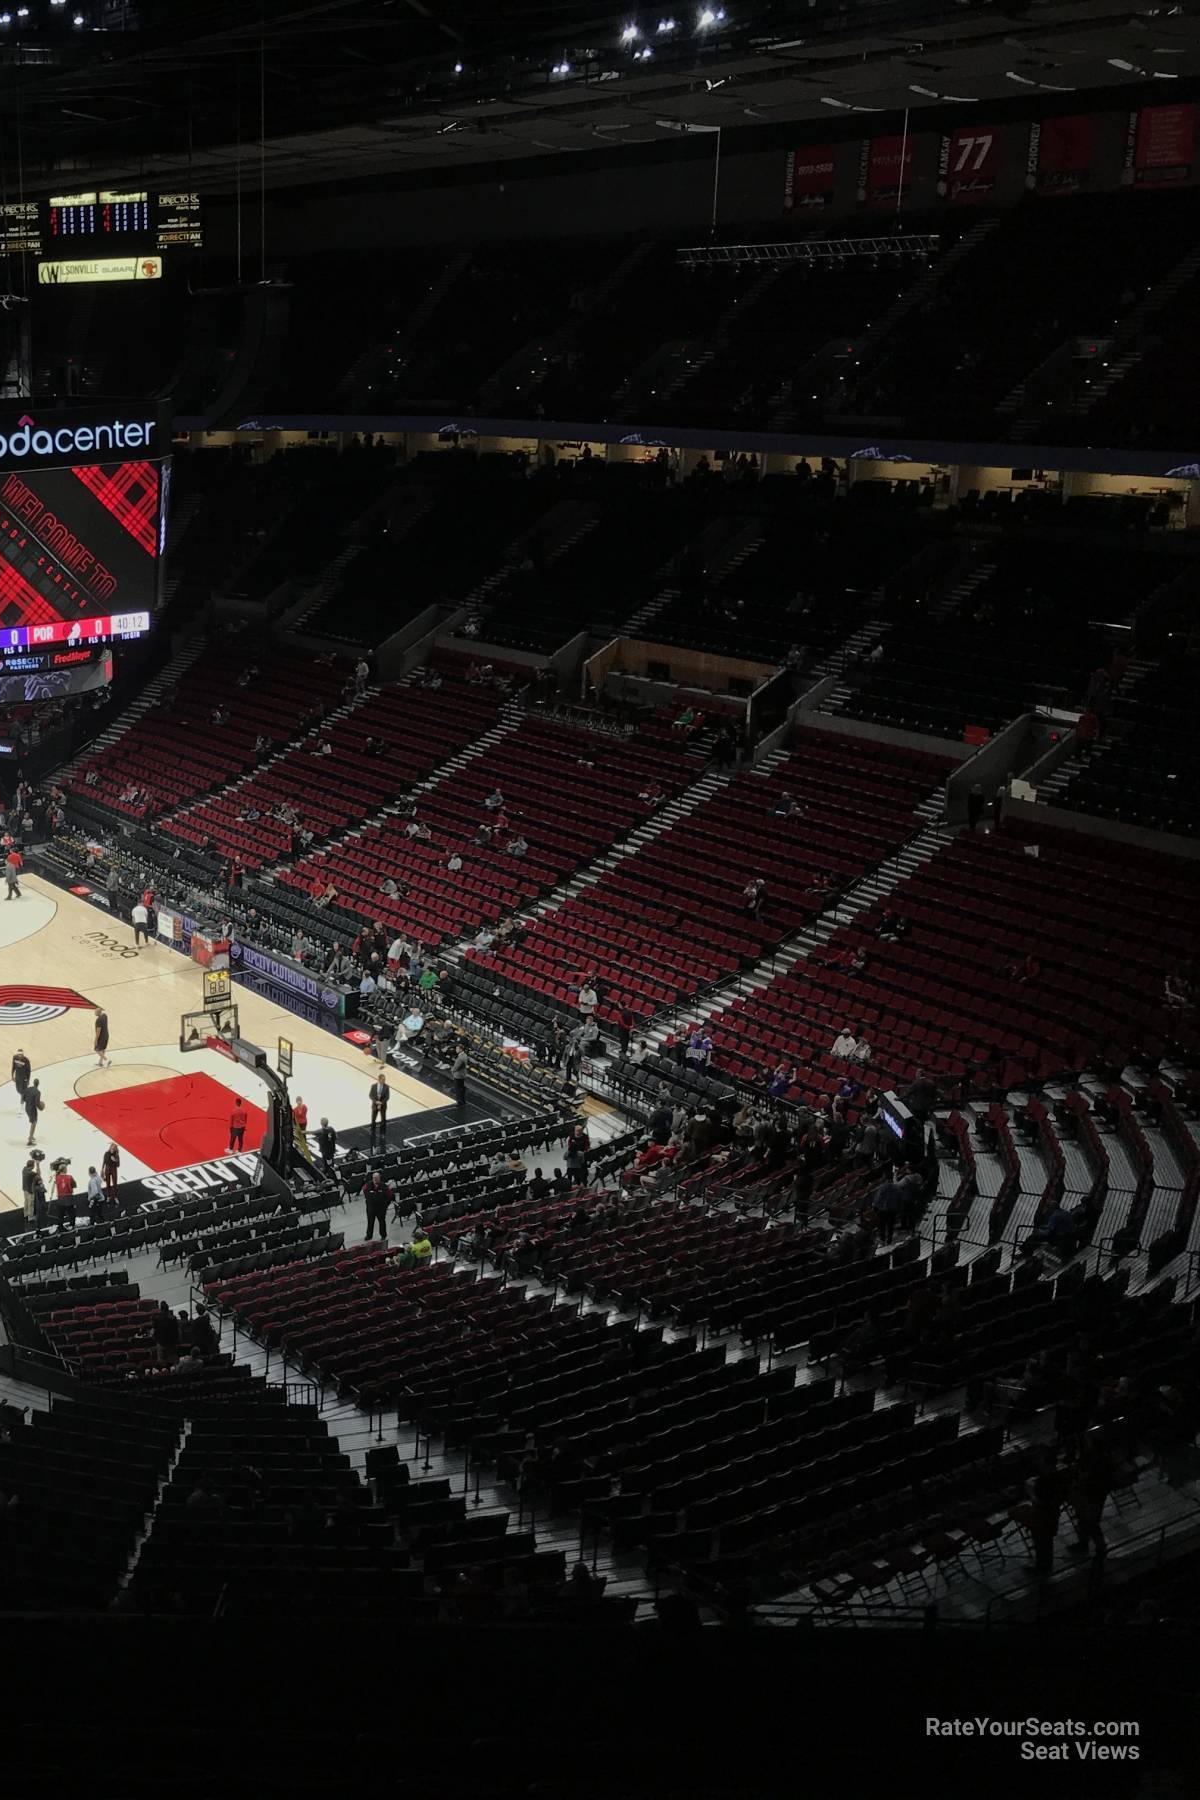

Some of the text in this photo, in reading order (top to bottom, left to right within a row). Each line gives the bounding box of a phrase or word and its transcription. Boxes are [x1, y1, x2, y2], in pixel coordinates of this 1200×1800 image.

[953, 134, 993, 172] 77
[47, 265, 99, 283] WILSONVILLE
[0, 472, 117, 600] WELCOME TO
[37, 557, 87, 609] CENTER
[11, 631, 18, 644] 0
[34, 626, 54, 641] POR
[96, 620, 102, 633] 0
[88, 636, 98, 644] FLS
[84, 932, 140, 958] moda
[244, 947, 318, 997] RIPCITY CLOTHING CO.
